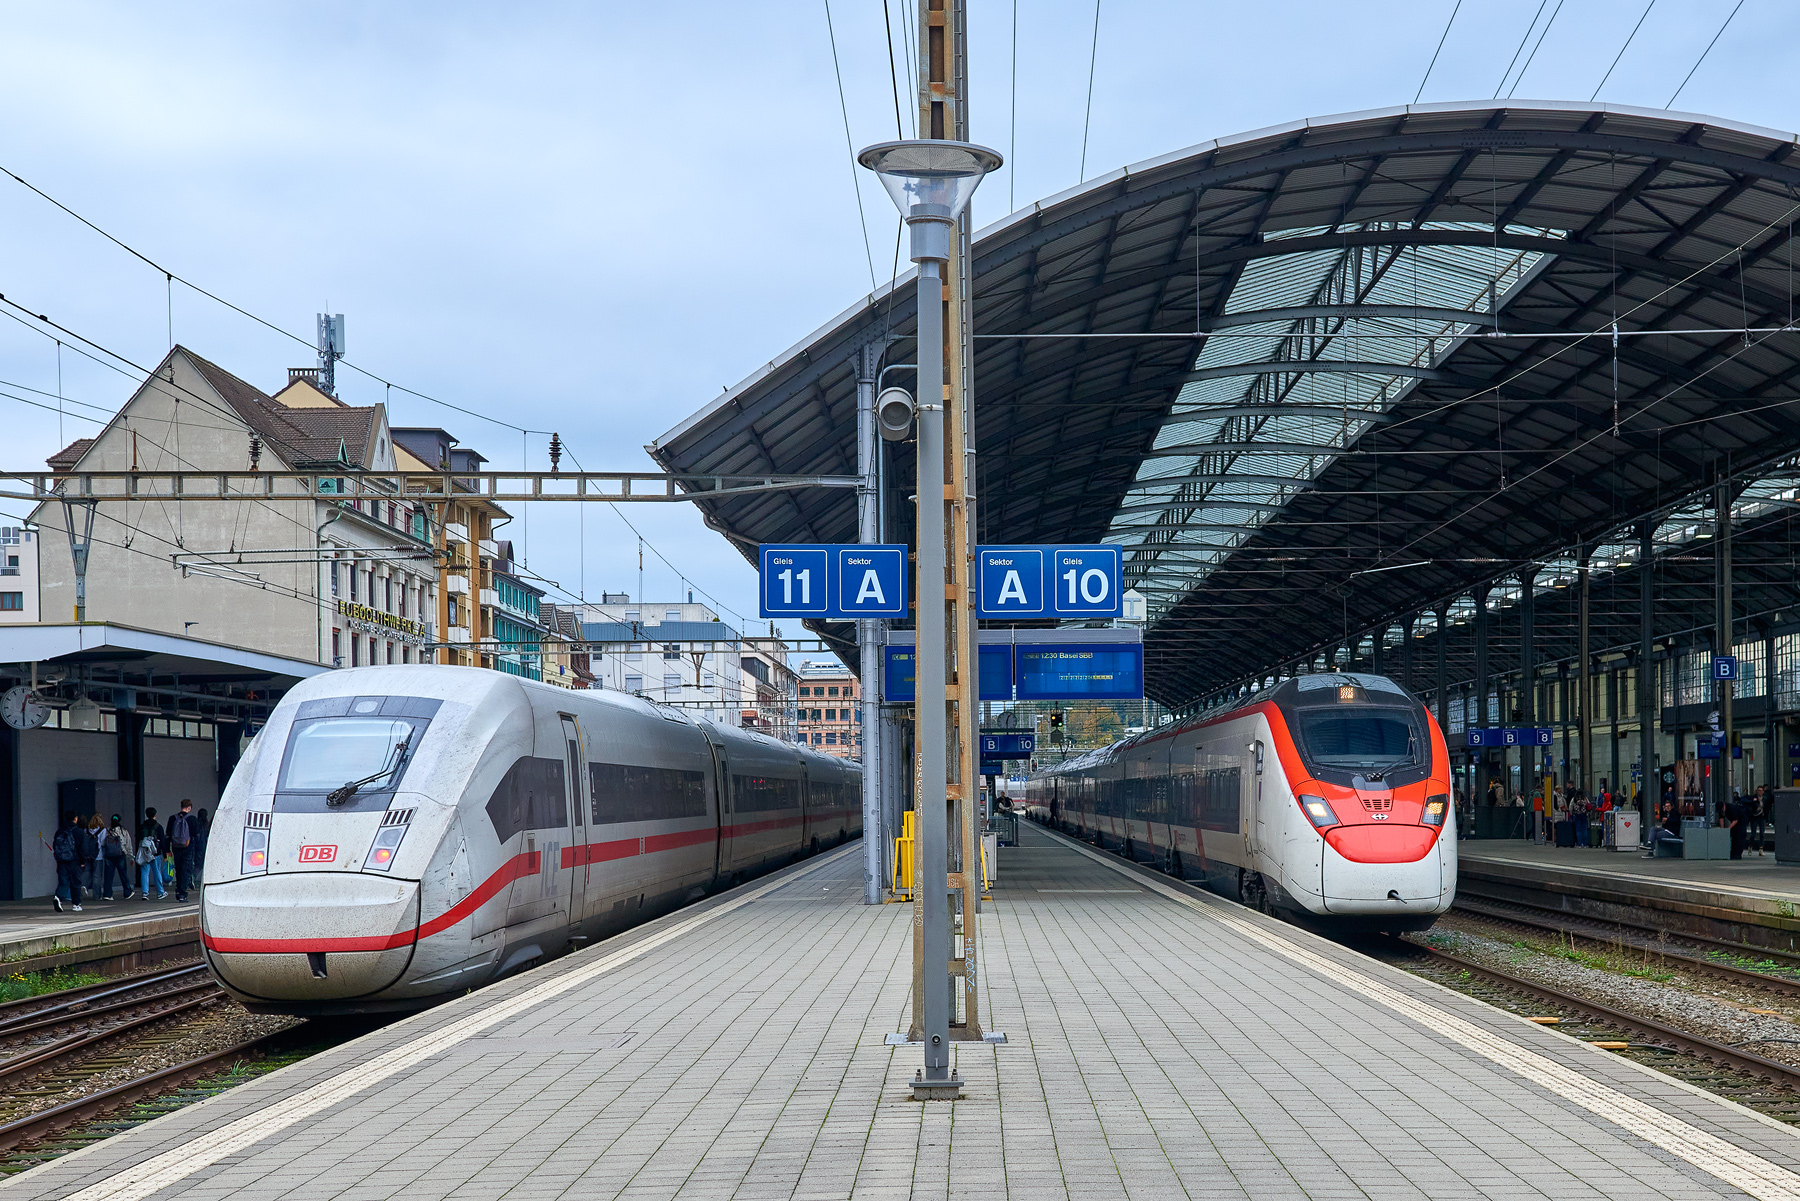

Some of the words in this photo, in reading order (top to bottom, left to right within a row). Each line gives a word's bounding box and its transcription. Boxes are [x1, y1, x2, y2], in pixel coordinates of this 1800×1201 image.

[989, 558, 1014, 566] Sektor
[778, 569, 810, 604] 11
[855, 569, 886, 604] A
[997, 570, 1028, 604] A
[1062, 568, 1109, 604] 10
[1720, 663, 1730, 676] B
[1020, 740, 1032, 749] 10
[1473, 734, 1480, 744] 9
[1506, 734, 1515, 743] B
[1541, 733, 1549, 743] 8
[988, 741, 996, 750] B
[303, 847, 333, 860] DB
[540, 841, 560, 898] ICE
